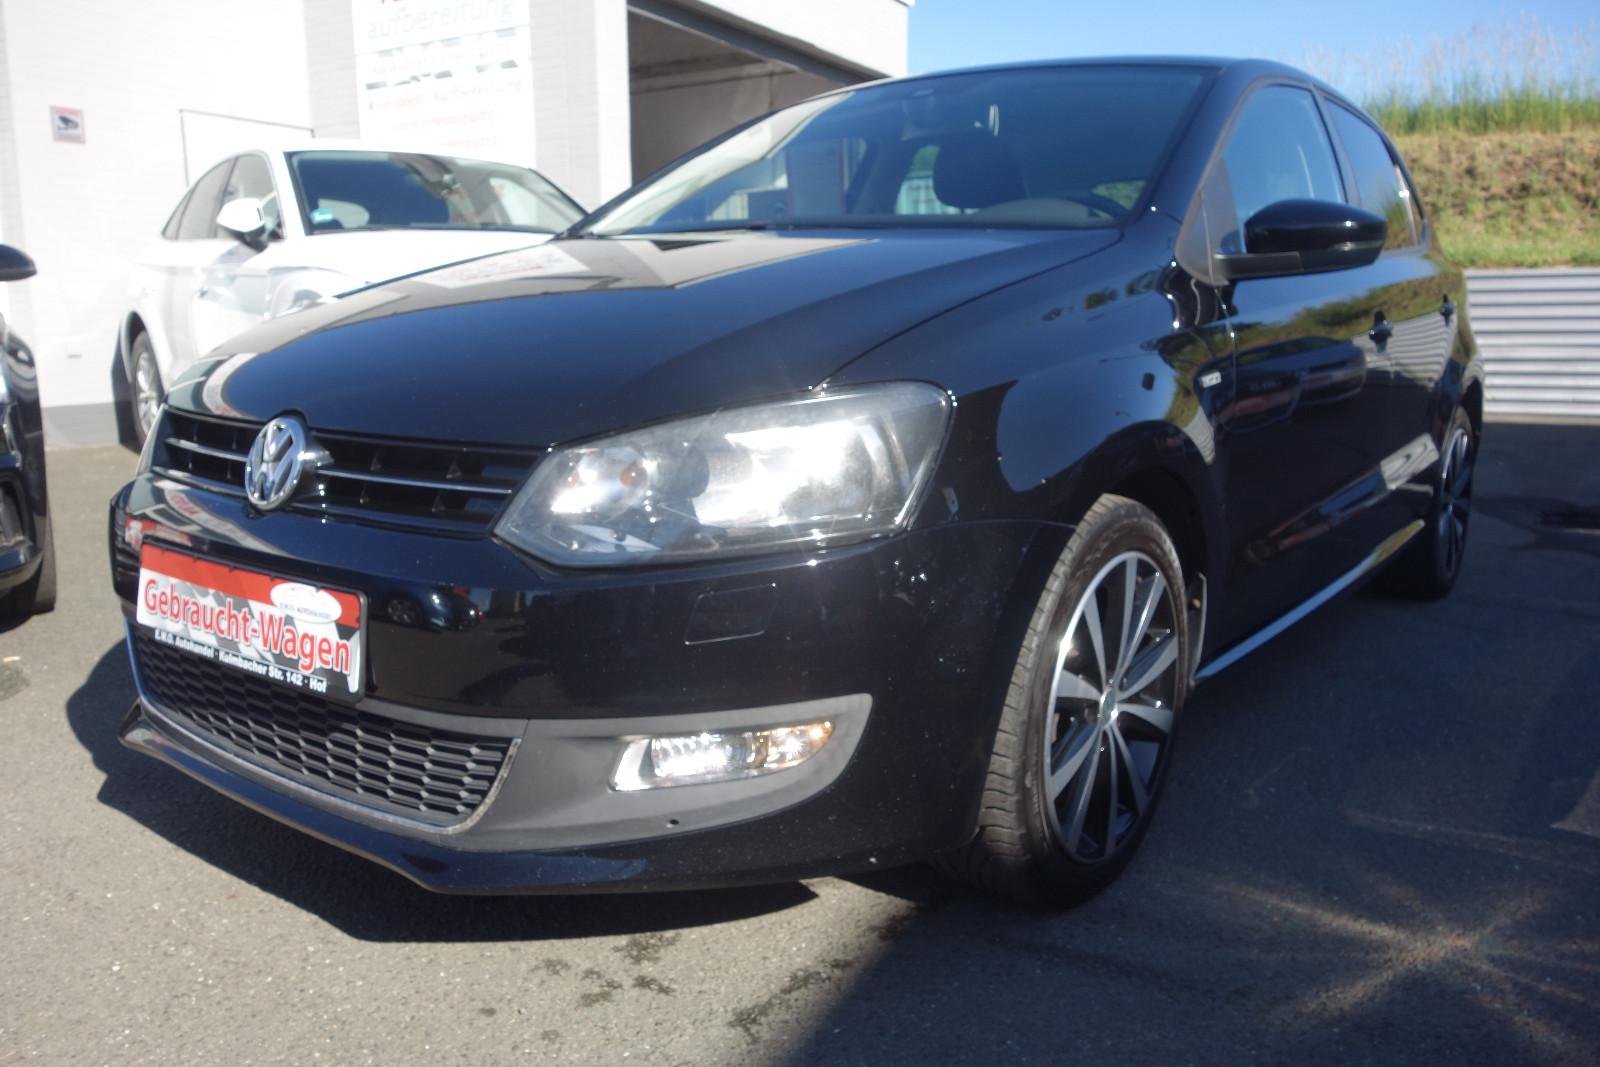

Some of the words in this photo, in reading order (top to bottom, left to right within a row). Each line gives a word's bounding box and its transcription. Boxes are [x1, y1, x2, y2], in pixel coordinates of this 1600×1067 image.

[143, 578, 350, 673] Gebraucht-Wagen
[268, 665, 284, 681] Str.
[286, 671, 303, 686] 142
[309, 677, 327, 693] Hof
